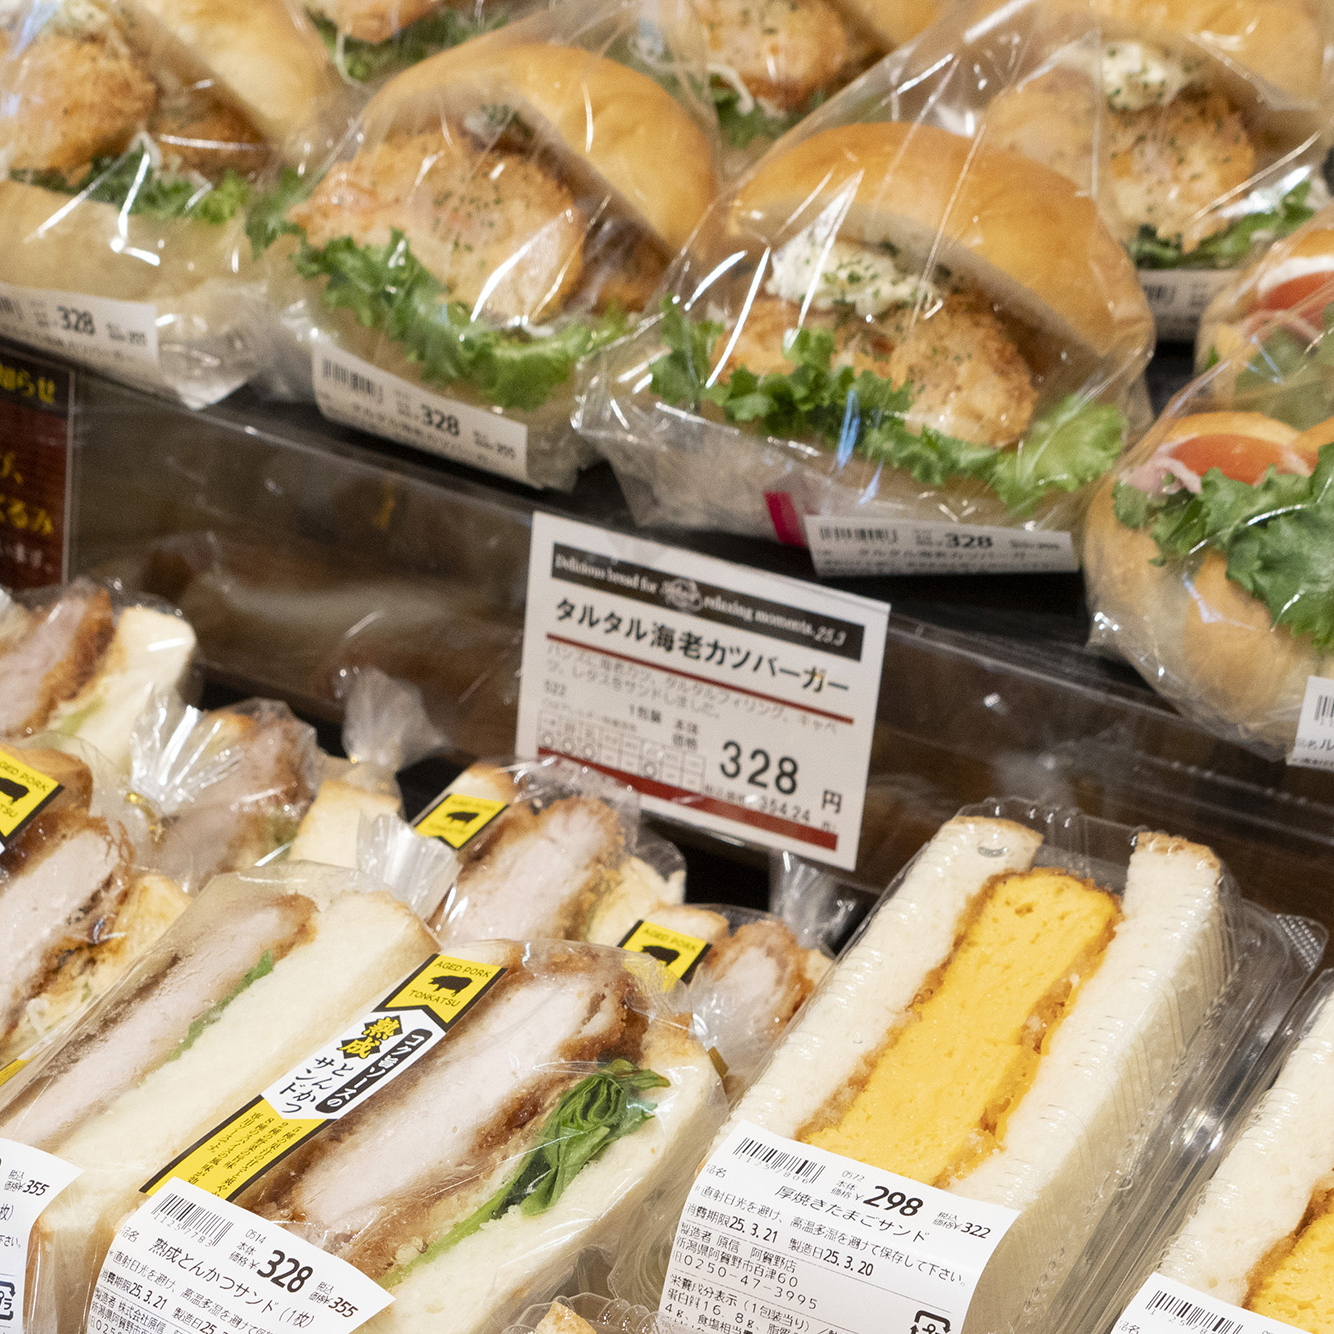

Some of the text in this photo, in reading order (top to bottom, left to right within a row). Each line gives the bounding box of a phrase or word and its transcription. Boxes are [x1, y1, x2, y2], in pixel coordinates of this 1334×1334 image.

[421, 404, 460, 436] 328
[944, 532, 993, 549] 328
[556, 598, 850, 694] タルタル海老カツバーガー
[720, 740, 799, 795] 328
[822, 790, 843, 813] 円
[434, 960, 492, 978] AGED PORK
[408, 989, 461, 1008] TONKATSU
[21, 1180, 49, 1197] 355
[774, 1185, 931, 1244] 厚焼きたまごサンド
[863, 1184, 992, 1240] 298 322
[148, 1236, 315, 1330] 熟成とんかつサンド(1枚)
[256, 1249, 359, 1319] 328 355
